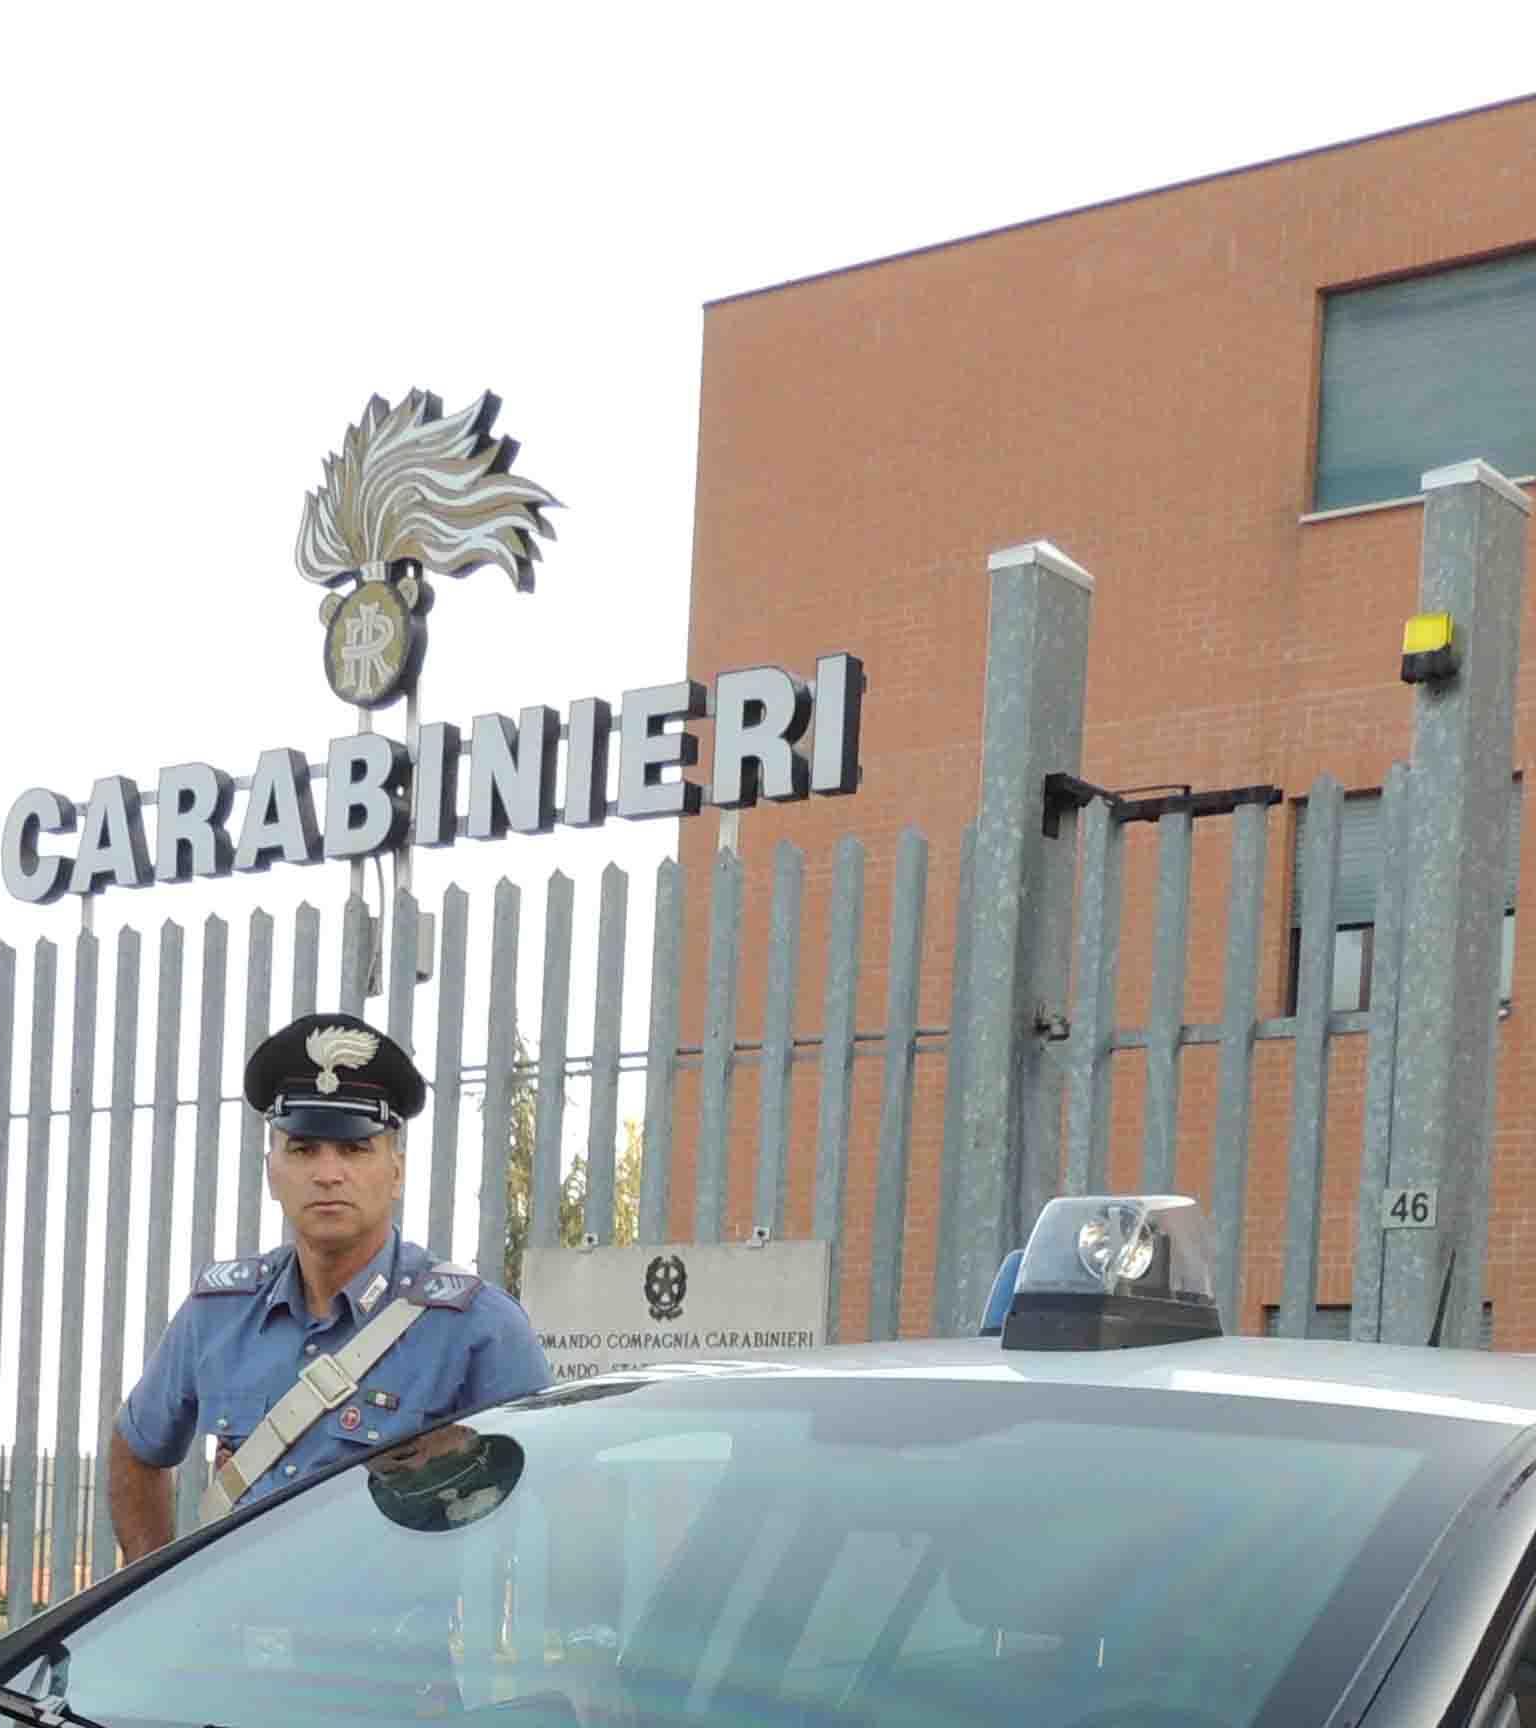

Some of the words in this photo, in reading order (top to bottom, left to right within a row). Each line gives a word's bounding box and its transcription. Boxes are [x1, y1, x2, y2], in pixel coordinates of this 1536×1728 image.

[1, 653, 860, 904] CARABINIERI
[1390, 1191, 1428, 1222] 46
[536, 1333, 602, 1350] OMANDO
[606, 1332, 700, 1350] COMPAGNIA
[704, 1330, 814, 1348] CARABINIERI
